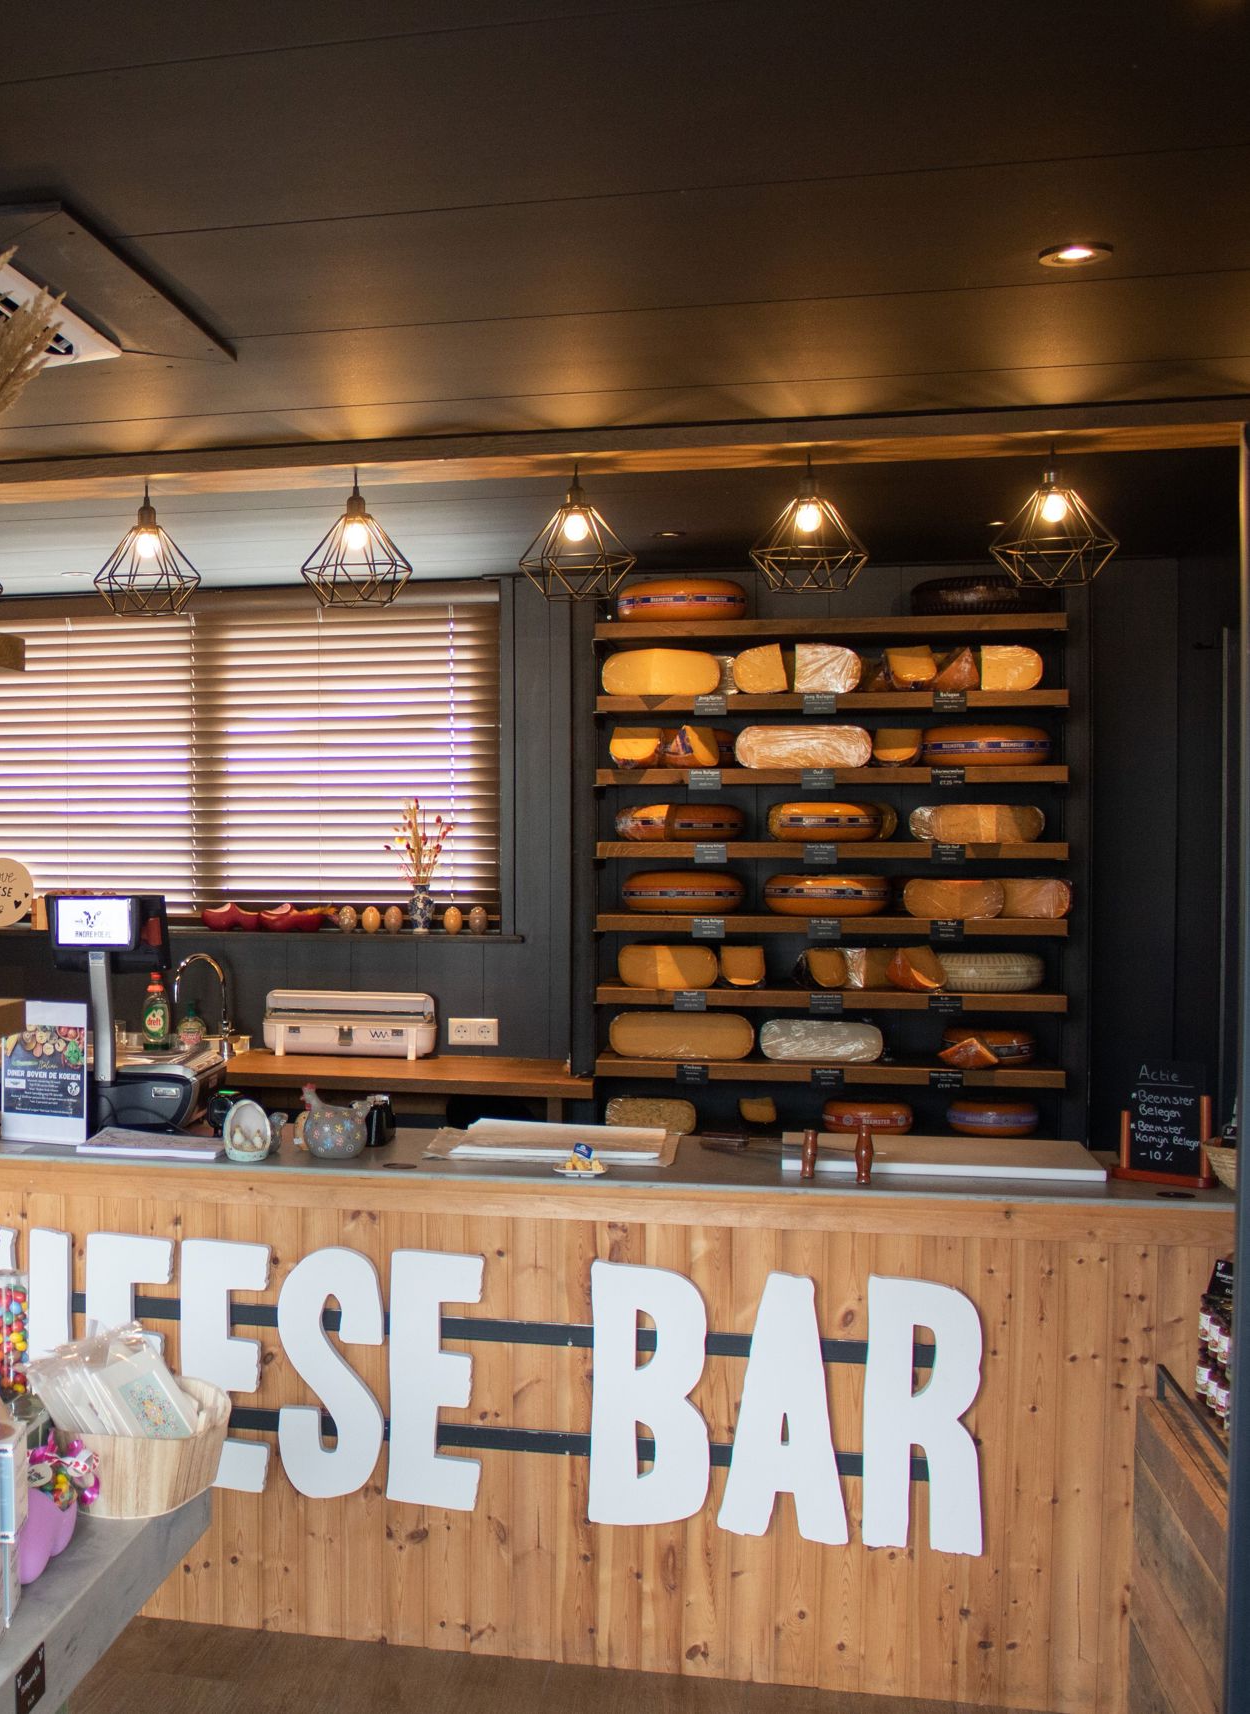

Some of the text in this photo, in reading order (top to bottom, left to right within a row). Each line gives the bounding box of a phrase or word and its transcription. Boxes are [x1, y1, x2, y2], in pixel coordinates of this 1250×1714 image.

[147, 1016, 162, 1026] dreft
[7, 1069, 25, 1077] DINER
[26, 1070, 48, 1079] BOVEN
[1138, 1064, 1180, 1082] Actie
[1138, 1089, 1195, 1106] Beemster
[1139, 1103, 1181, 1121] Belegen
[862, 1118, 891, 1126] BEEMSTER
[1137, 1120, 1186, 1135] Beemster
[588, 1259, 984, 1557] BAR
